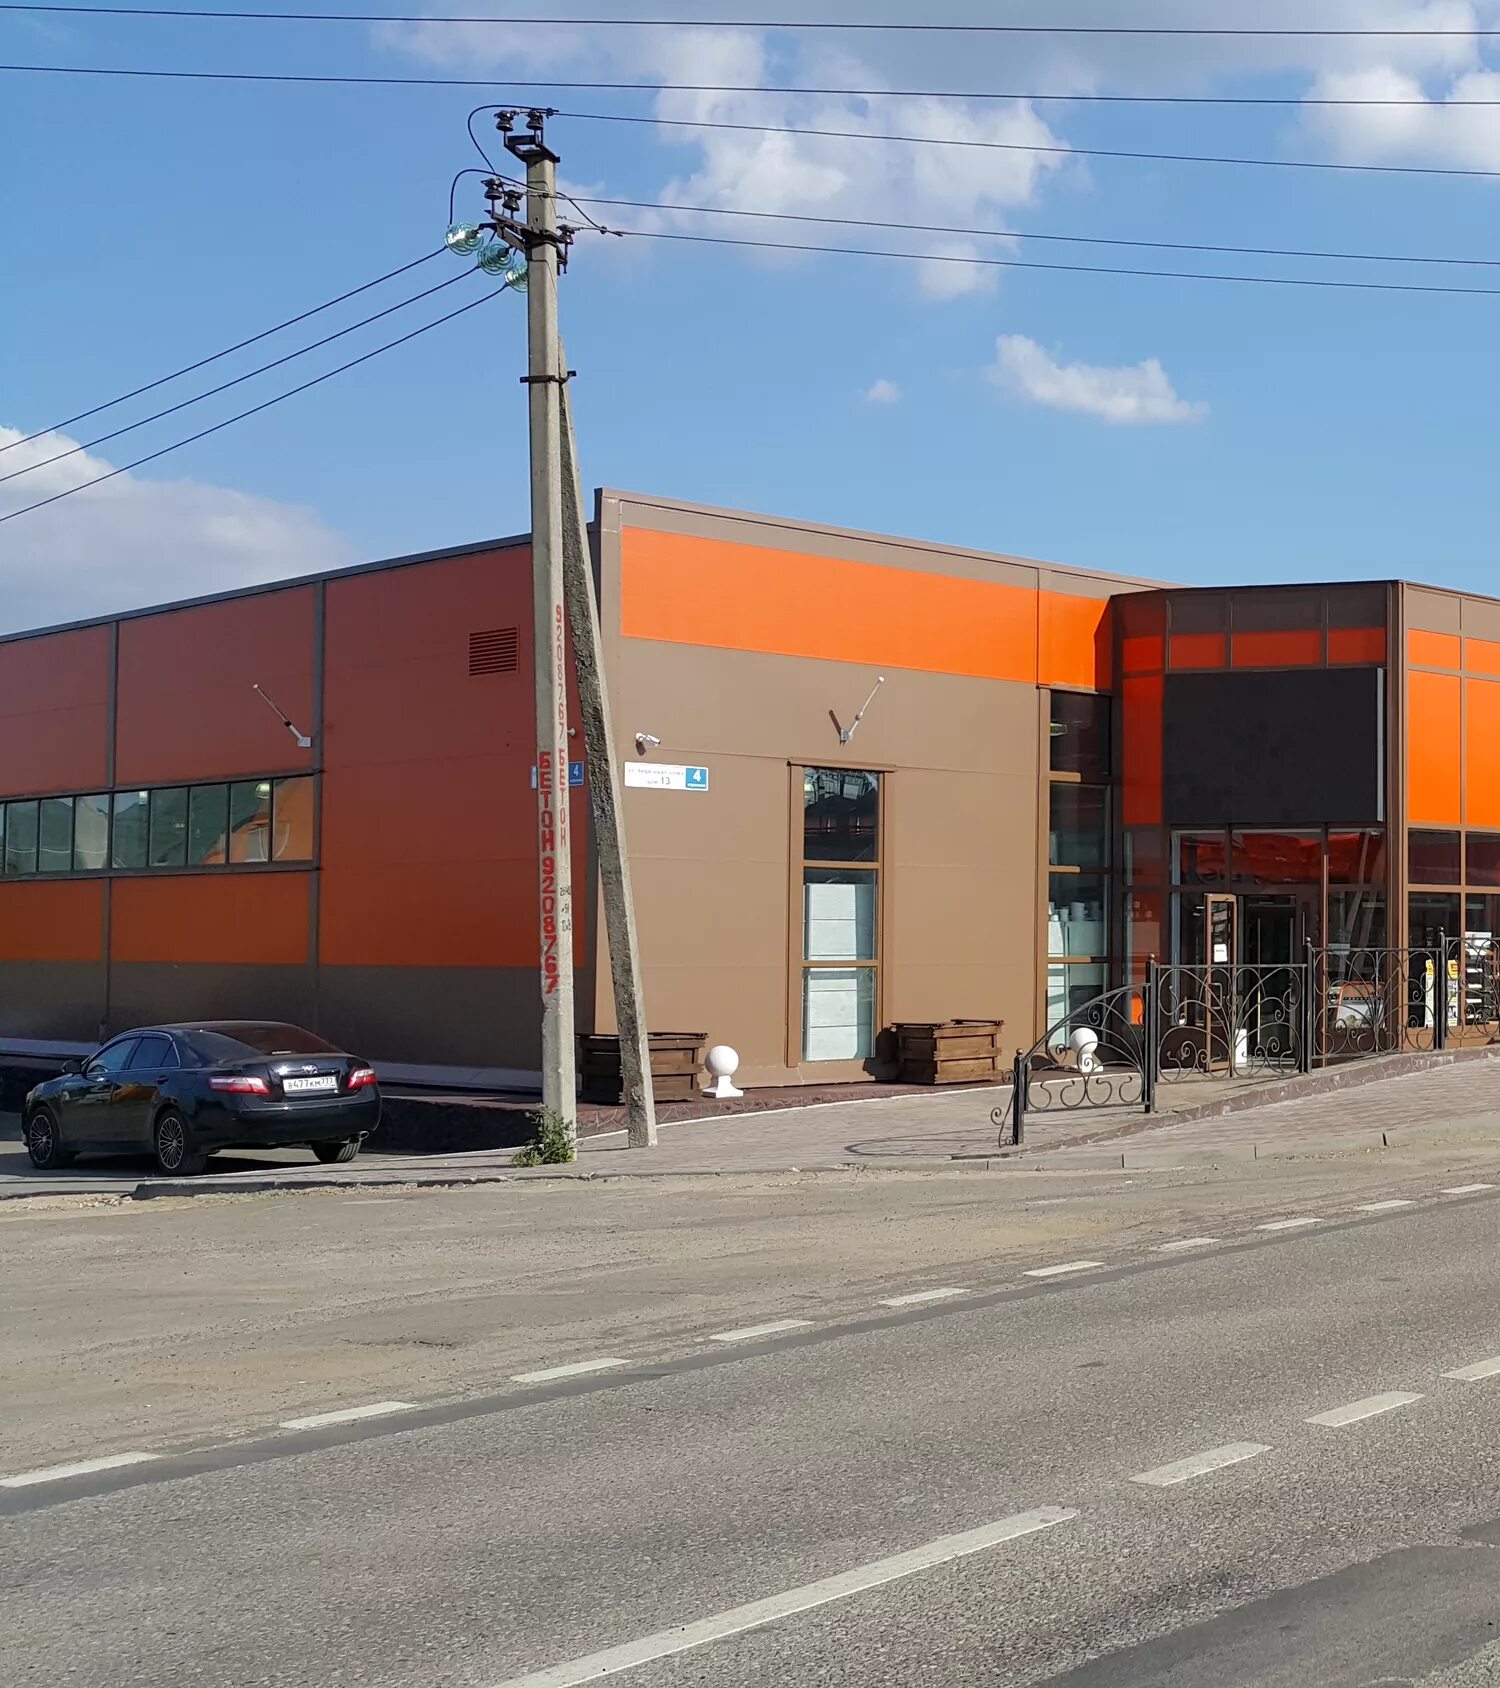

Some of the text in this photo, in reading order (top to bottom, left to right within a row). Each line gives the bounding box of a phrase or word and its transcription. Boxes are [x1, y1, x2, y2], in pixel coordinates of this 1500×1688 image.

[573, 764, 579, 777] 4
[692, 769, 702, 782] 4
[538, 751, 560, 994] БЕТОН 9208767
